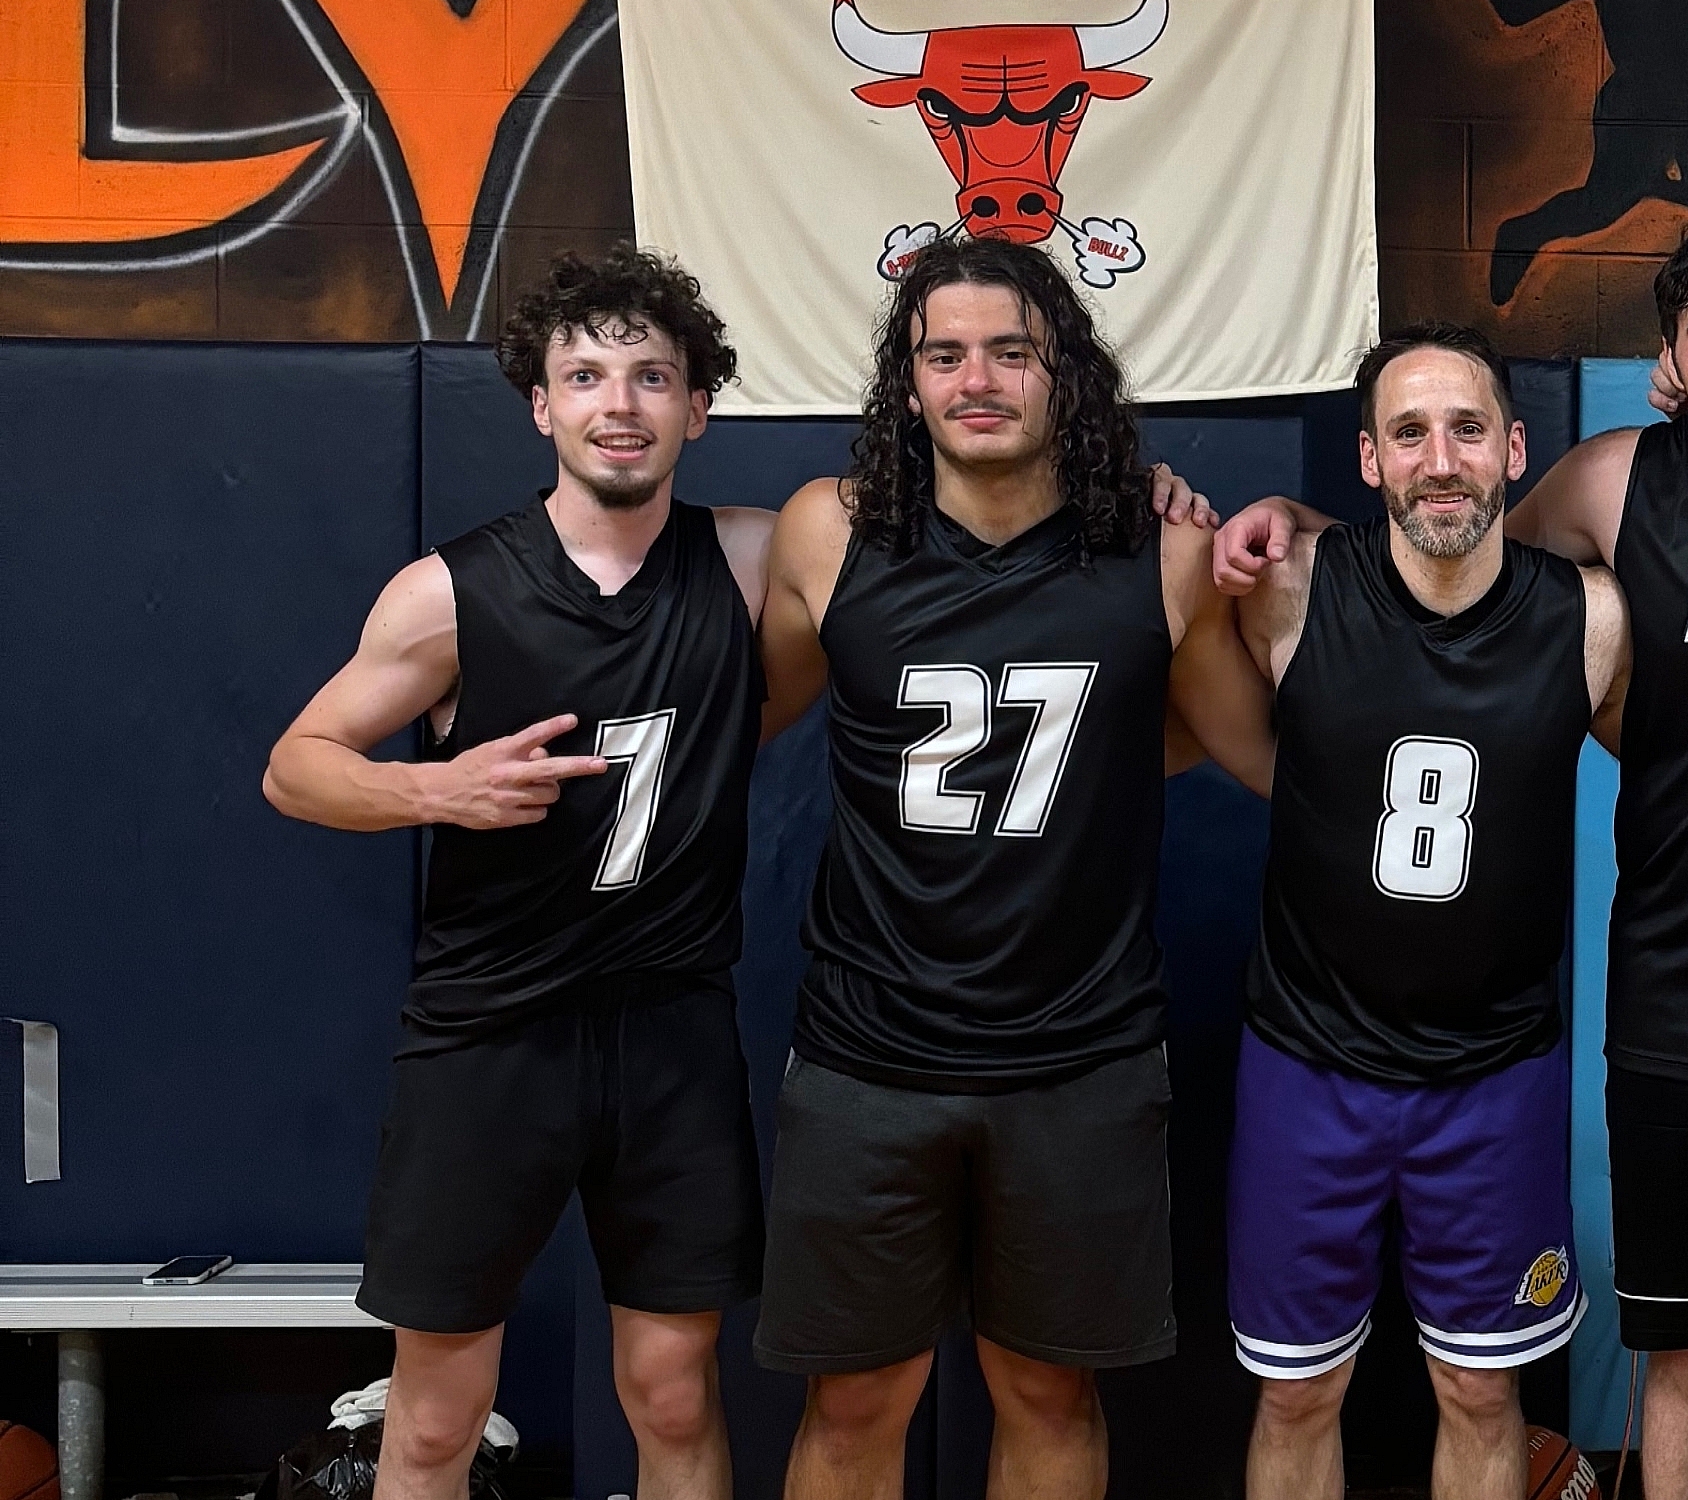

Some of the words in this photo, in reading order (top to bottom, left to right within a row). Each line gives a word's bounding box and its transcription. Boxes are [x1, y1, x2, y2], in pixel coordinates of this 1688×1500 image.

[1087, 236, 1129, 262] BULLZ
[592, 708, 678, 892] 7
[897, 662, 1100, 838] 27
[1372, 735, 1480, 902] 8
